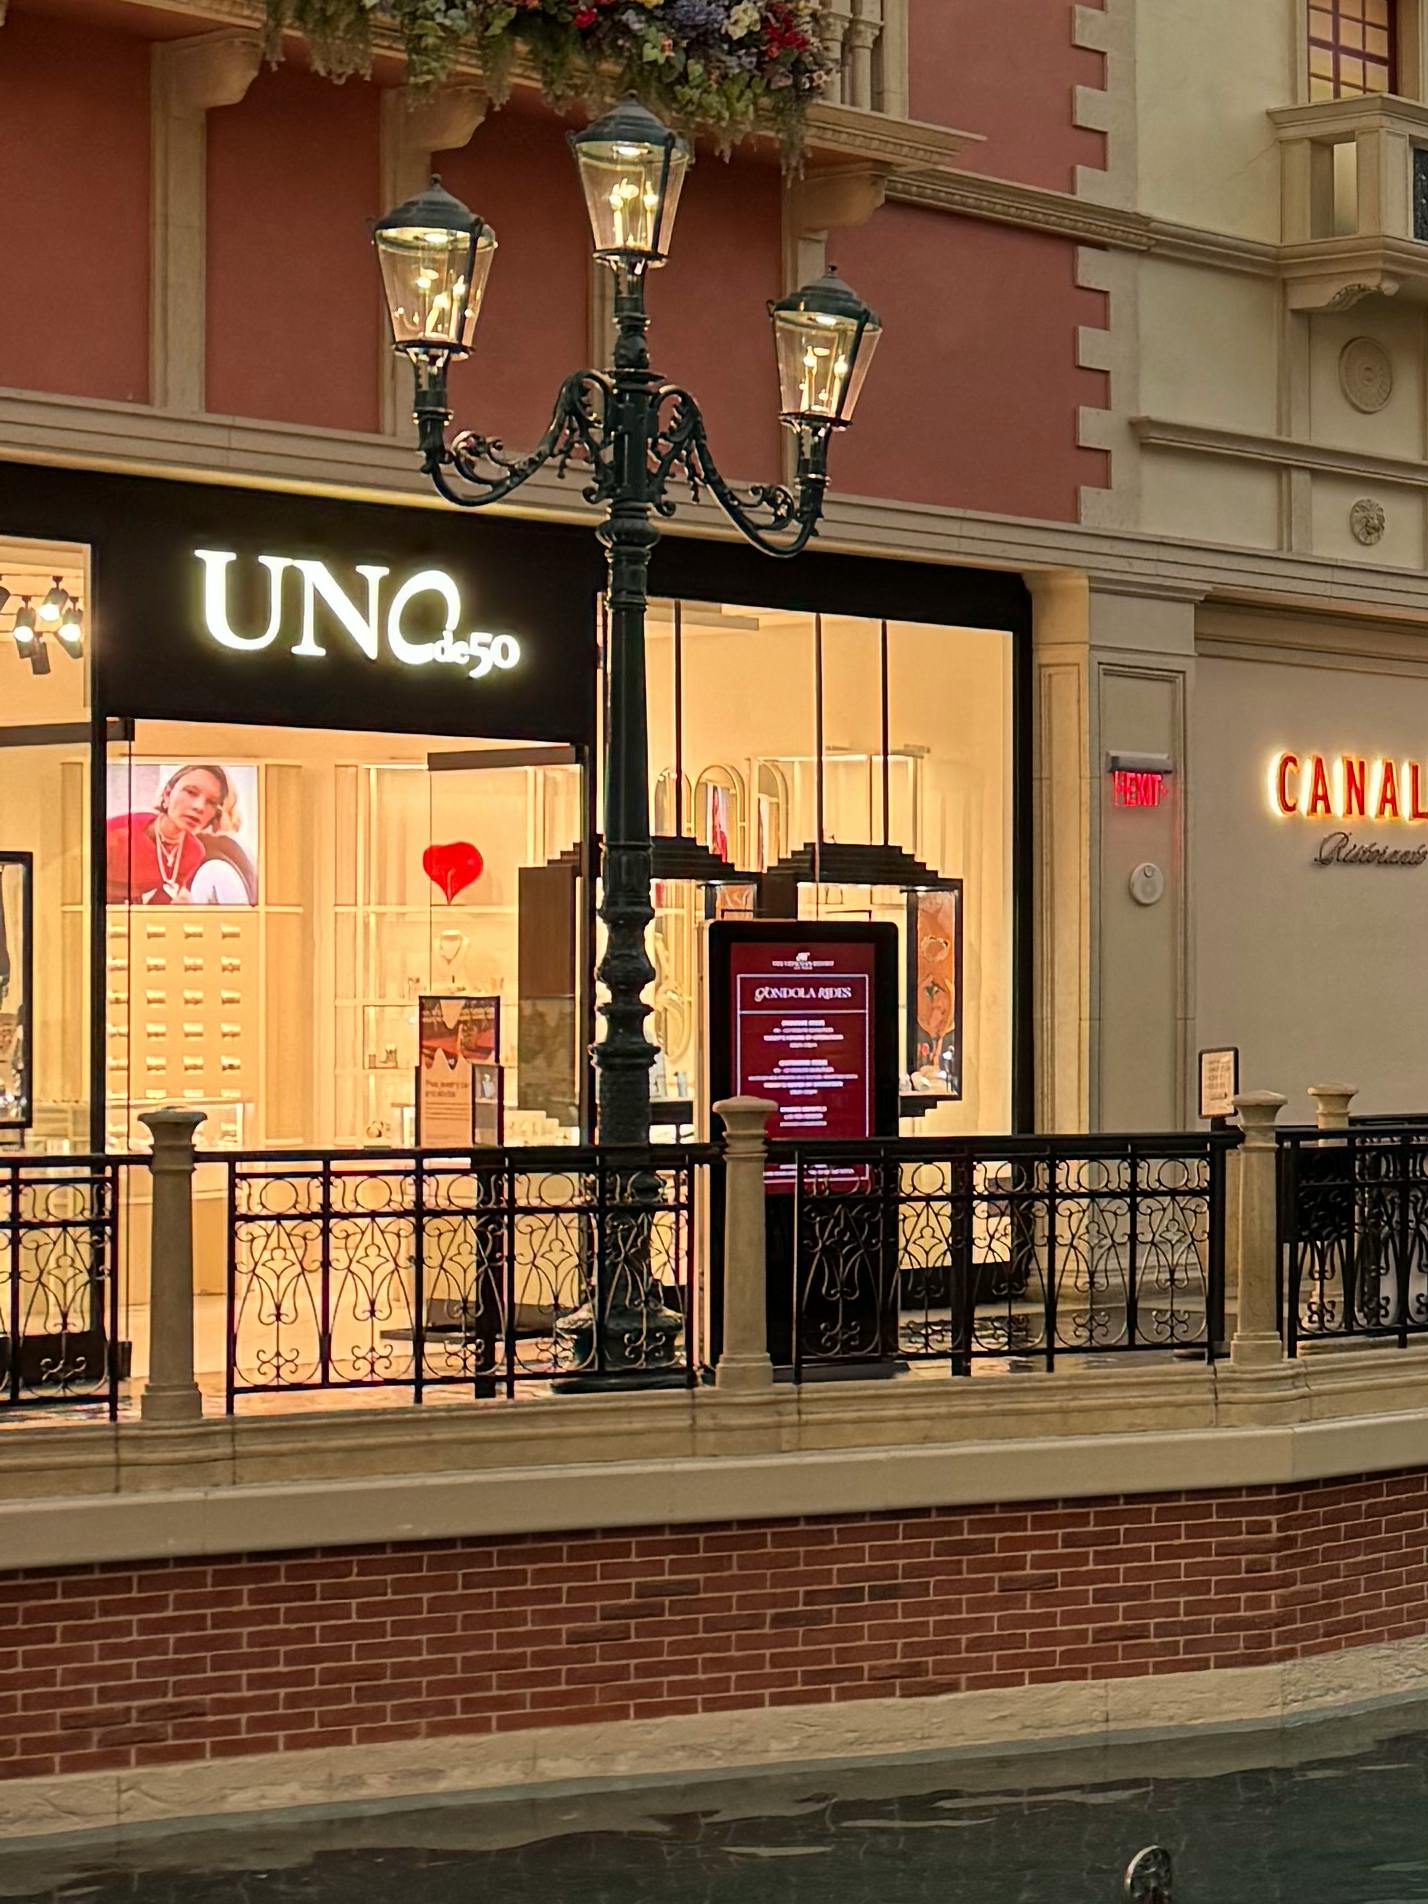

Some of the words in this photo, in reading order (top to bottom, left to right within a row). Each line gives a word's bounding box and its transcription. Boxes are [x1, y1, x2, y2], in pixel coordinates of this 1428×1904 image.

[1126, 771, 1162, 807] EXIT
[754, 986, 816, 1002] GONDOLA
[818, 986, 852, 1000] RIDES
